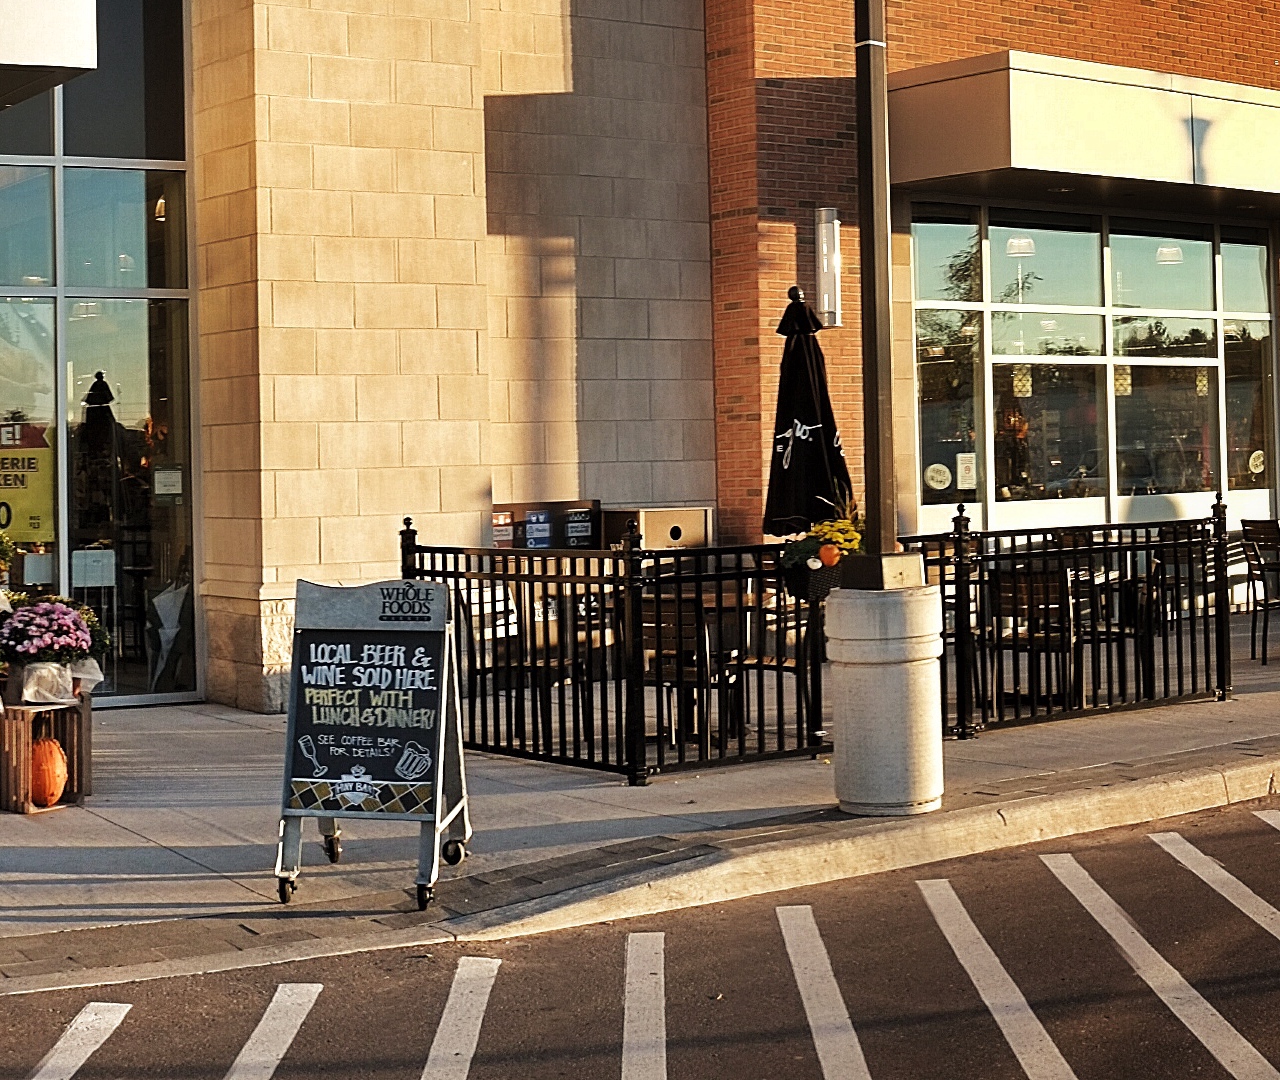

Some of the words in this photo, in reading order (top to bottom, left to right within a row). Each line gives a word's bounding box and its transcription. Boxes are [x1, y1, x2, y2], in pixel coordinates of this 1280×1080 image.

[380, 582, 434, 601] WHOLE
[381, 601, 430, 614] FOODS
[310, 643, 358, 664] LOCAL
[359, 644, 406, 667] BEER
[411, 647, 432, 668] &
[301, 665, 346, 686] WINE
[352, 666, 392, 690] SOLD
[305, 688, 362, 706] PERFECT
[369, 690, 413, 708] WITH
[312, 706, 360, 727] LUNCH
[317, 734, 335, 745] SEE
[341, 736, 373, 746] COFFEE
[377, 737, 402, 748] BAR
[329, 746, 350, 757] FOR
[352, 747, 395, 758] DETAILS!
